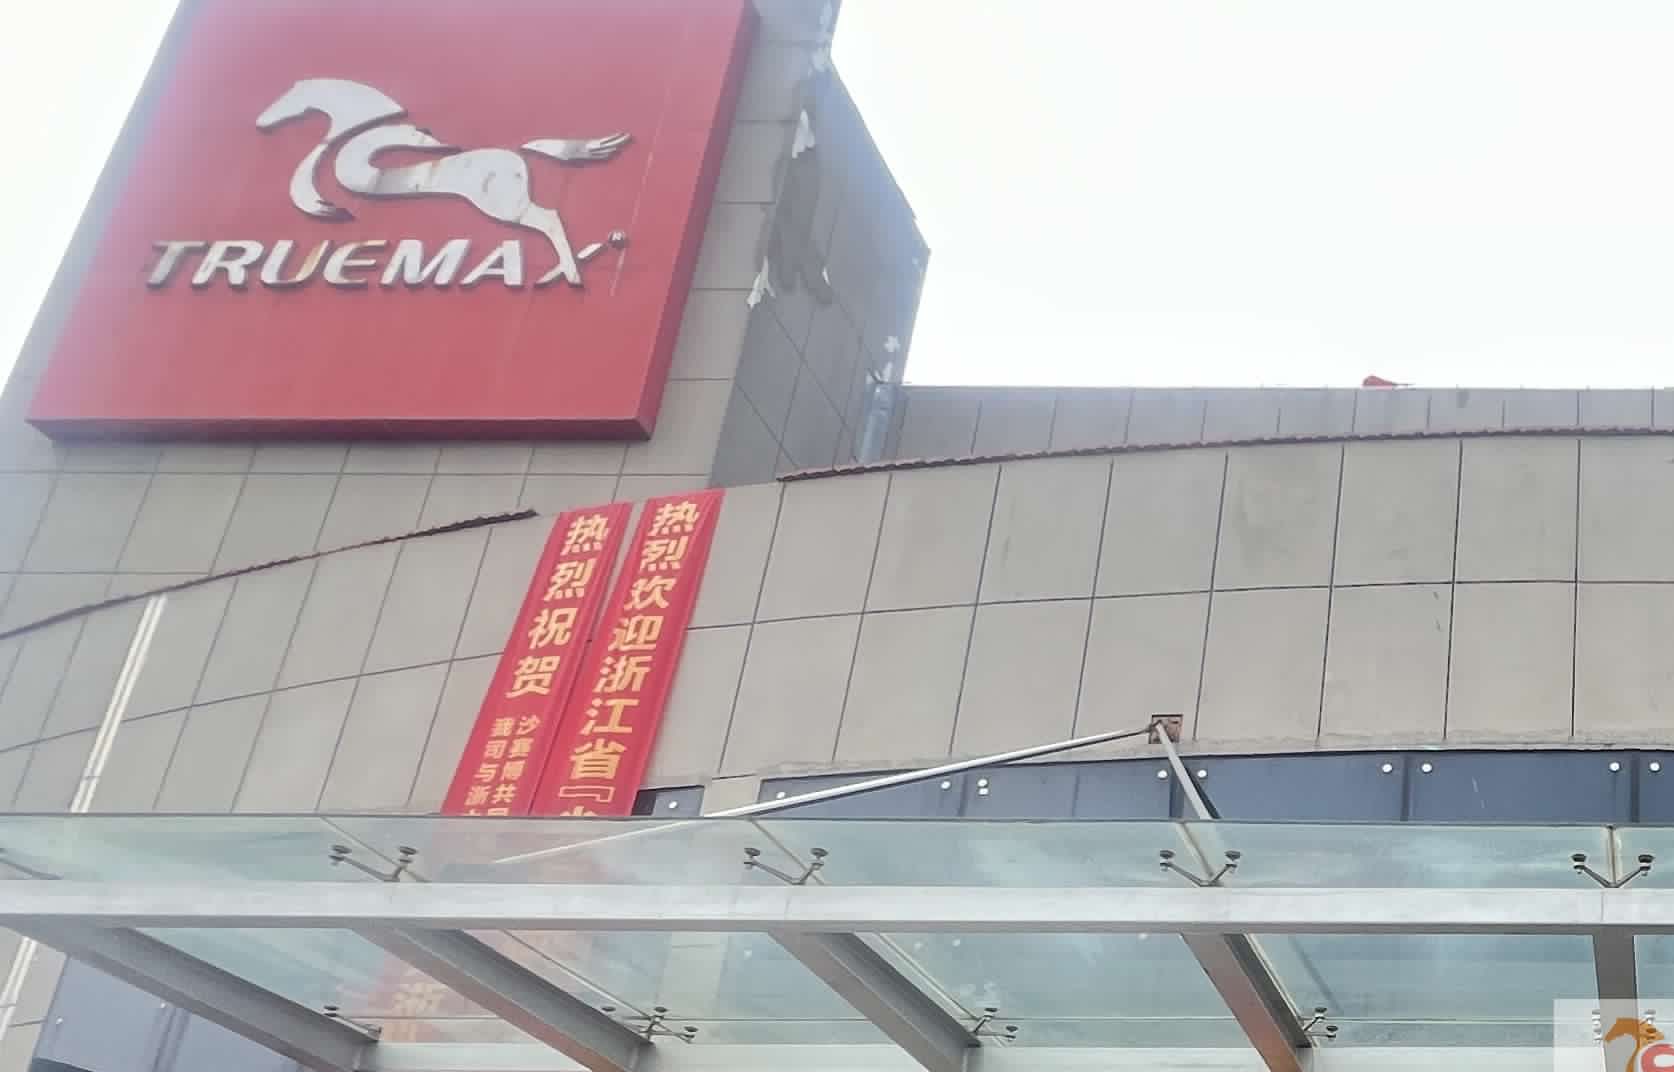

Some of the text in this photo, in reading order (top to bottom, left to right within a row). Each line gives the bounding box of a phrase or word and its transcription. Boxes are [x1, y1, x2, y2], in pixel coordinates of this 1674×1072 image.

[146, 237, 609, 289] TRUEMAX
[505, 513, 609, 699] 热烈祝贺
